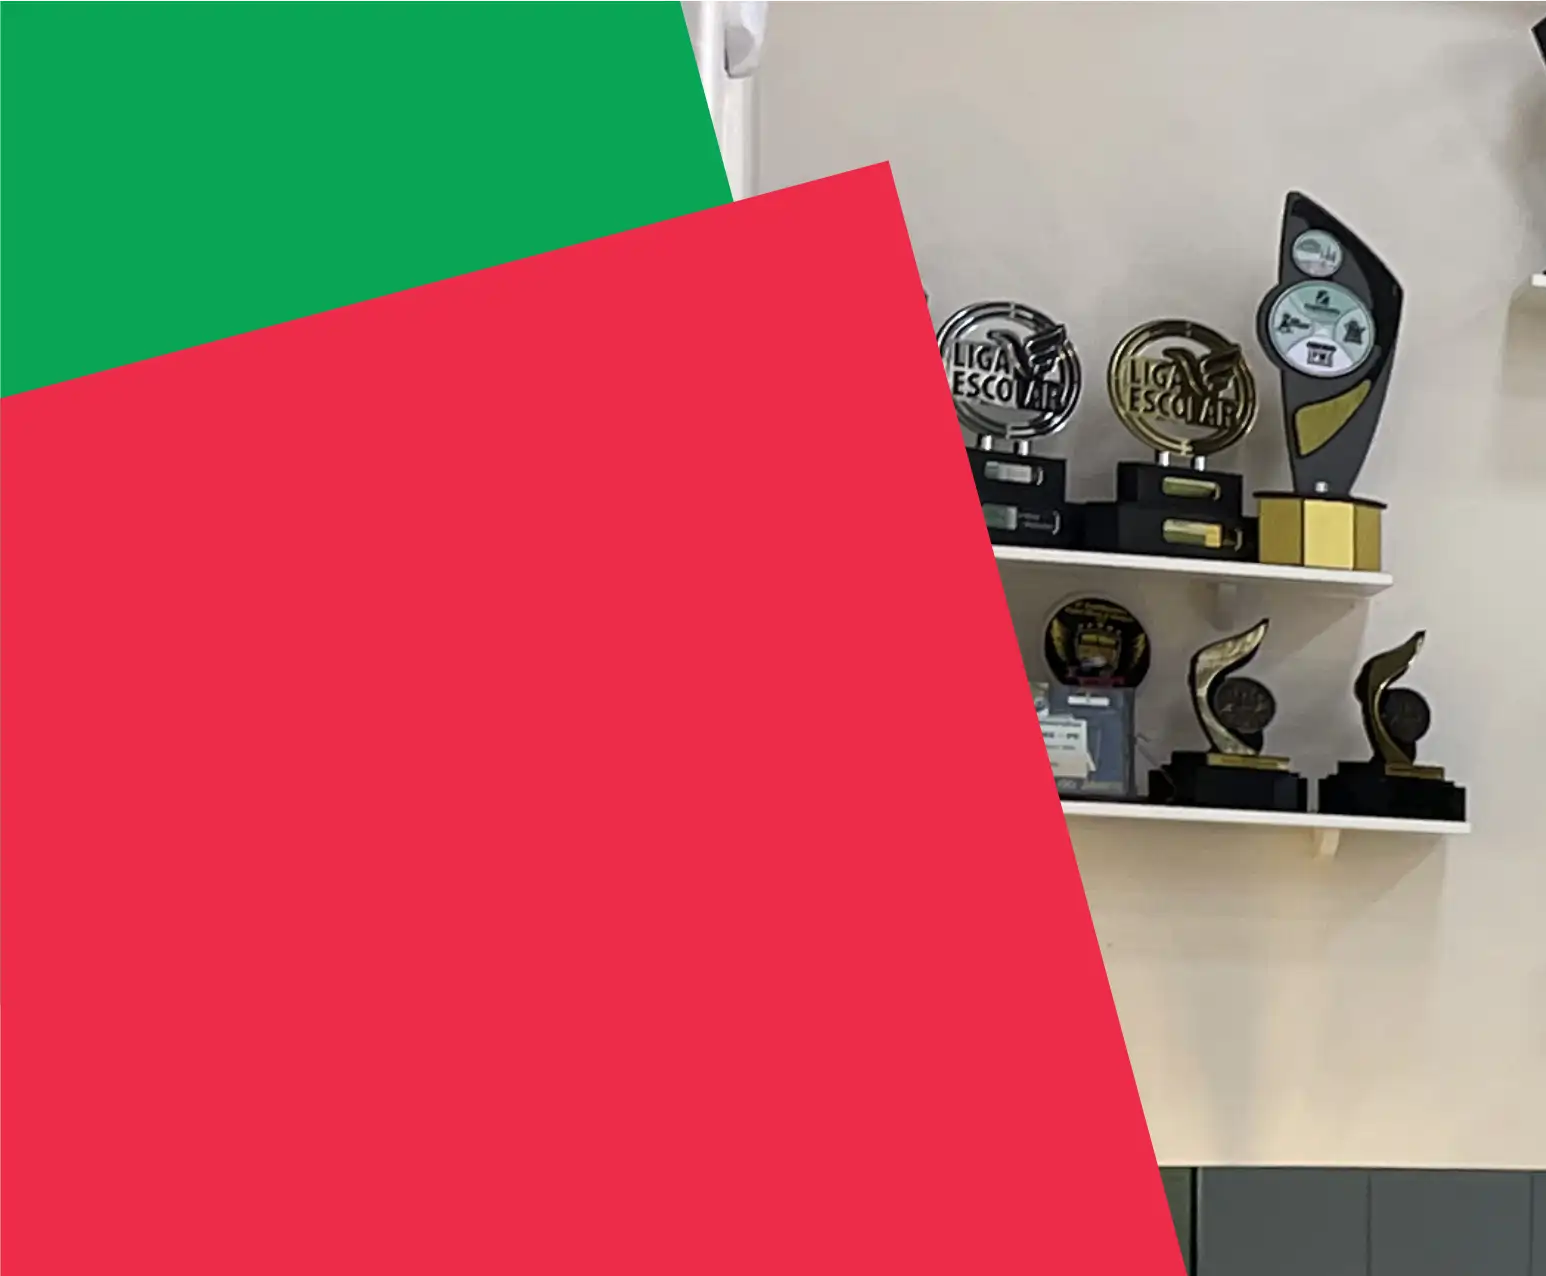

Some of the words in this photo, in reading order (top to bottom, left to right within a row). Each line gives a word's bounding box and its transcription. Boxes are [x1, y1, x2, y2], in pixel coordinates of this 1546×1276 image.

[953, 341, 1011, 372] LIGA
[1130, 359, 1186, 389] LIGA
[952, 373, 1063, 414] ESCOLAR
[1129, 388, 1237, 430] ESCOLAR
